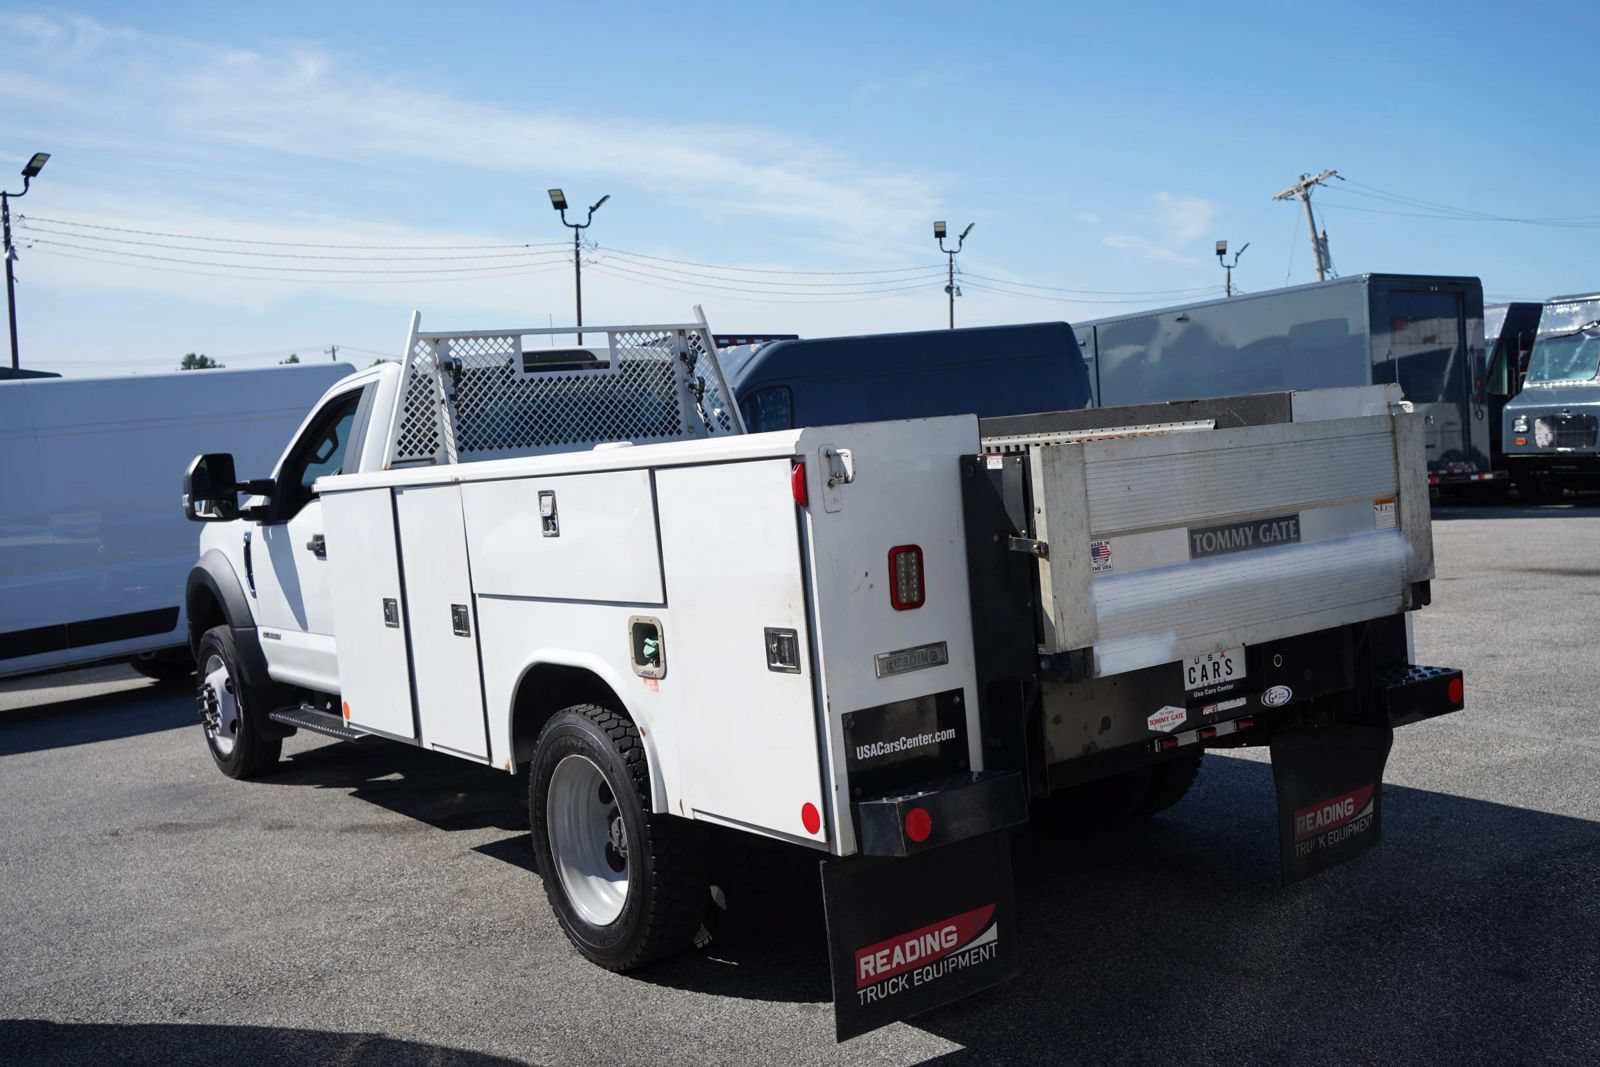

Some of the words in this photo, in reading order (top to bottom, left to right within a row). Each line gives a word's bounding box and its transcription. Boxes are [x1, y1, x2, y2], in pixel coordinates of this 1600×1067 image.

[1193, 527, 1255, 553] TOMMY
[1259, 519, 1298, 543] GATE
[886, 650, 939, 673] READING
[1188, 658, 1232, 684] CARS
[1217, 684, 1234, 692] Center
[1149, 715, 1169, 726] TOMMY
[1170, 712, 1185, 721] GATE
[856, 728, 956, 760] USACarsCenter.com
[1296, 797, 1354, 834] READING
[1327, 814, 1374, 846] EQUIPMENT
[859, 925, 958, 980] READING
[857, 973, 910, 1006] TRUCK
[913, 941, 999, 987] EQUIPMENT
